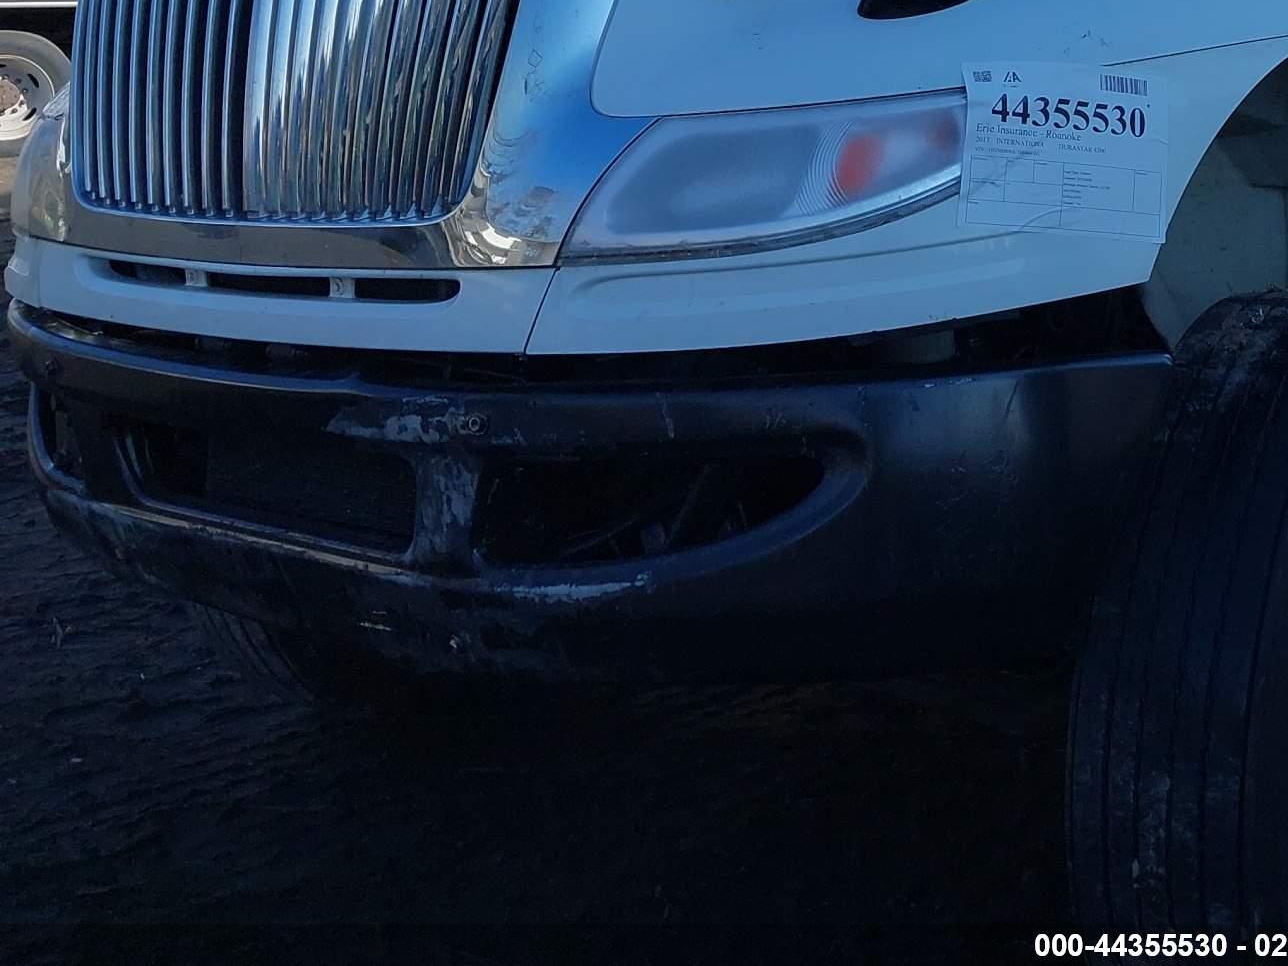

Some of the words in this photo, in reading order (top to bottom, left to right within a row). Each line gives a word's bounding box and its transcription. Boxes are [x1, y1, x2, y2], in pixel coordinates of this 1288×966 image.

[991, 93, 1146, 138] 44355530
[976, 123, 995, 133] Erie
[997, 124, 1038, 137] Insurance
[1046, 129, 1082, 141] Roanoke
